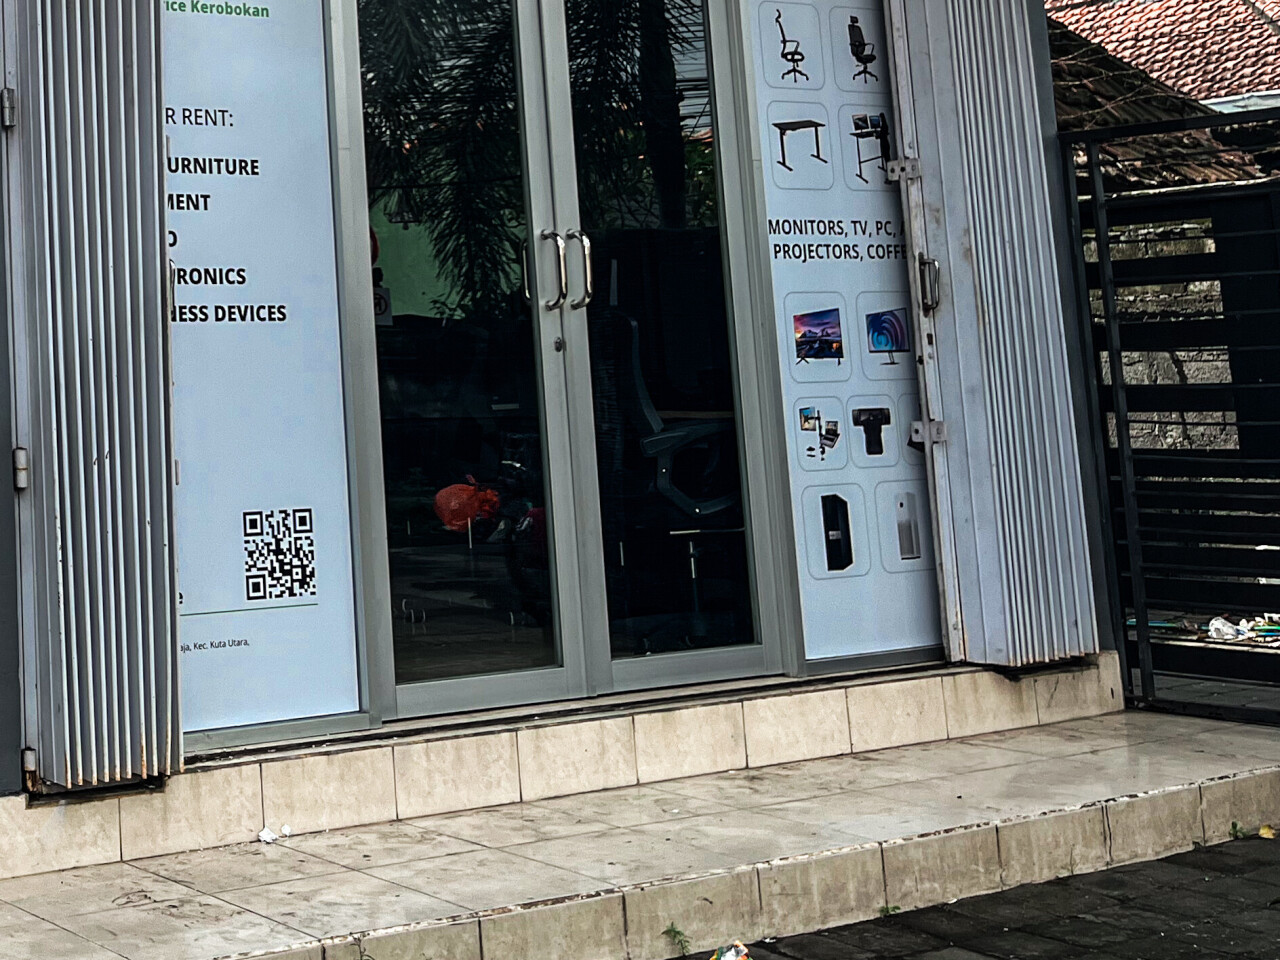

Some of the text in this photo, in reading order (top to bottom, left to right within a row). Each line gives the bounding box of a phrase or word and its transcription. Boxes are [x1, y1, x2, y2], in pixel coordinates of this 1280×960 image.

[191, 0, 270, 18] Kerobokan
[182, 108, 234, 127] RENT:
[768, 219, 848, 238] MONITORS,
[851, 220, 873, 238] TV,
[875, 220, 897, 238] PC,
[773, 243, 864, 263] PROJECTORS,
[214, 304, 287, 323] DEVICES
[210, 640, 227, 649] Kuta
